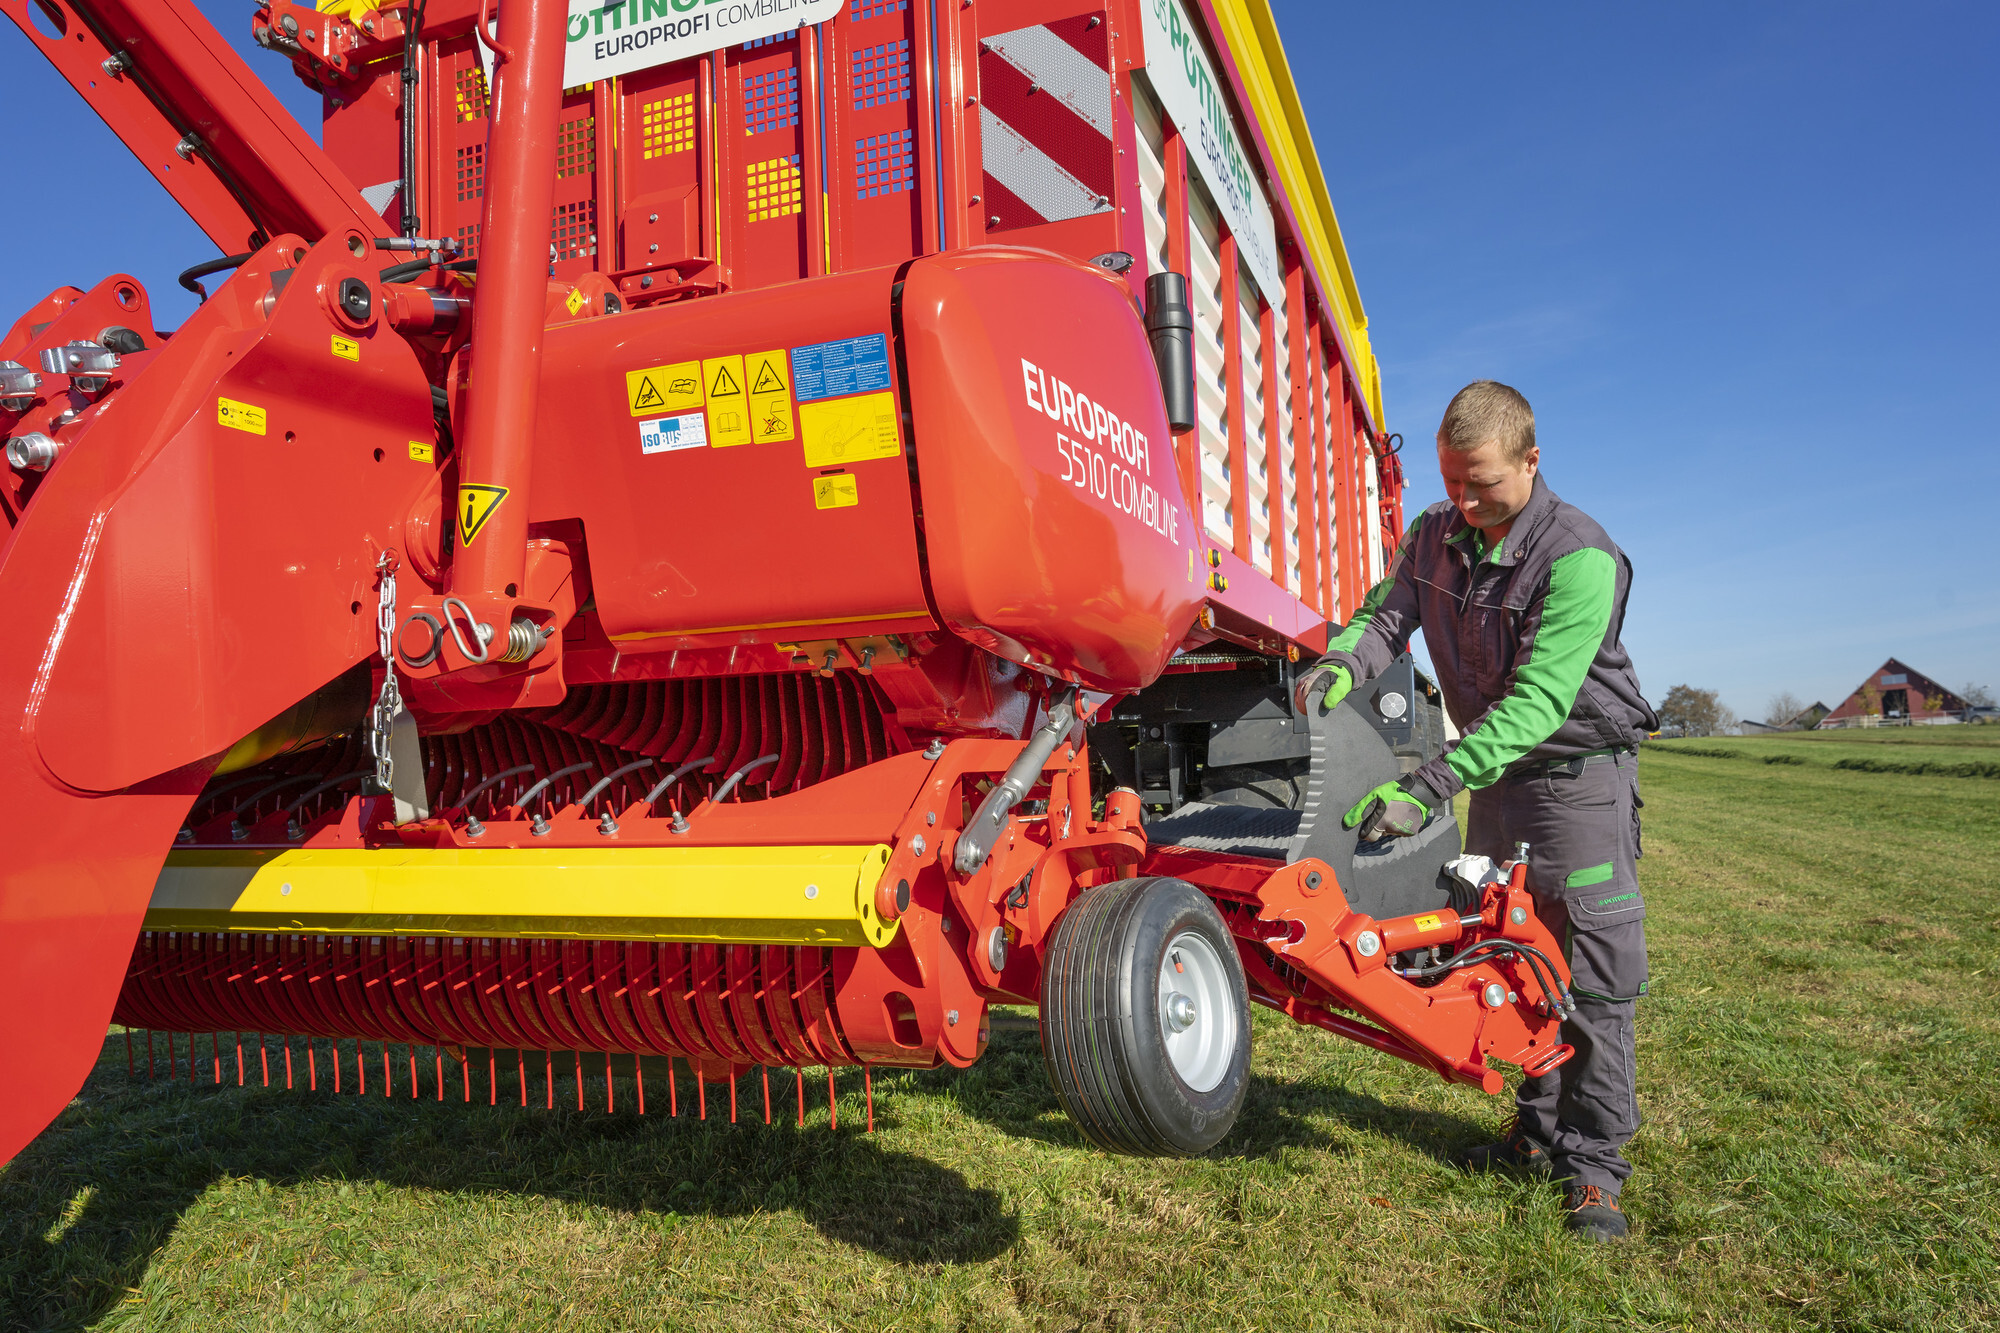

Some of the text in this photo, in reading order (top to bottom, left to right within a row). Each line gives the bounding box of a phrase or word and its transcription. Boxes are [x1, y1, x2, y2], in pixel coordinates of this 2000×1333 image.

[595, 13, 710, 60] EUROPROFI
[1200, 117, 1241, 225] EUROPROFI
[1021, 357, 1150, 477] EUROPROFI
[1056, 431, 1179, 546] 5510 COMBILINE
